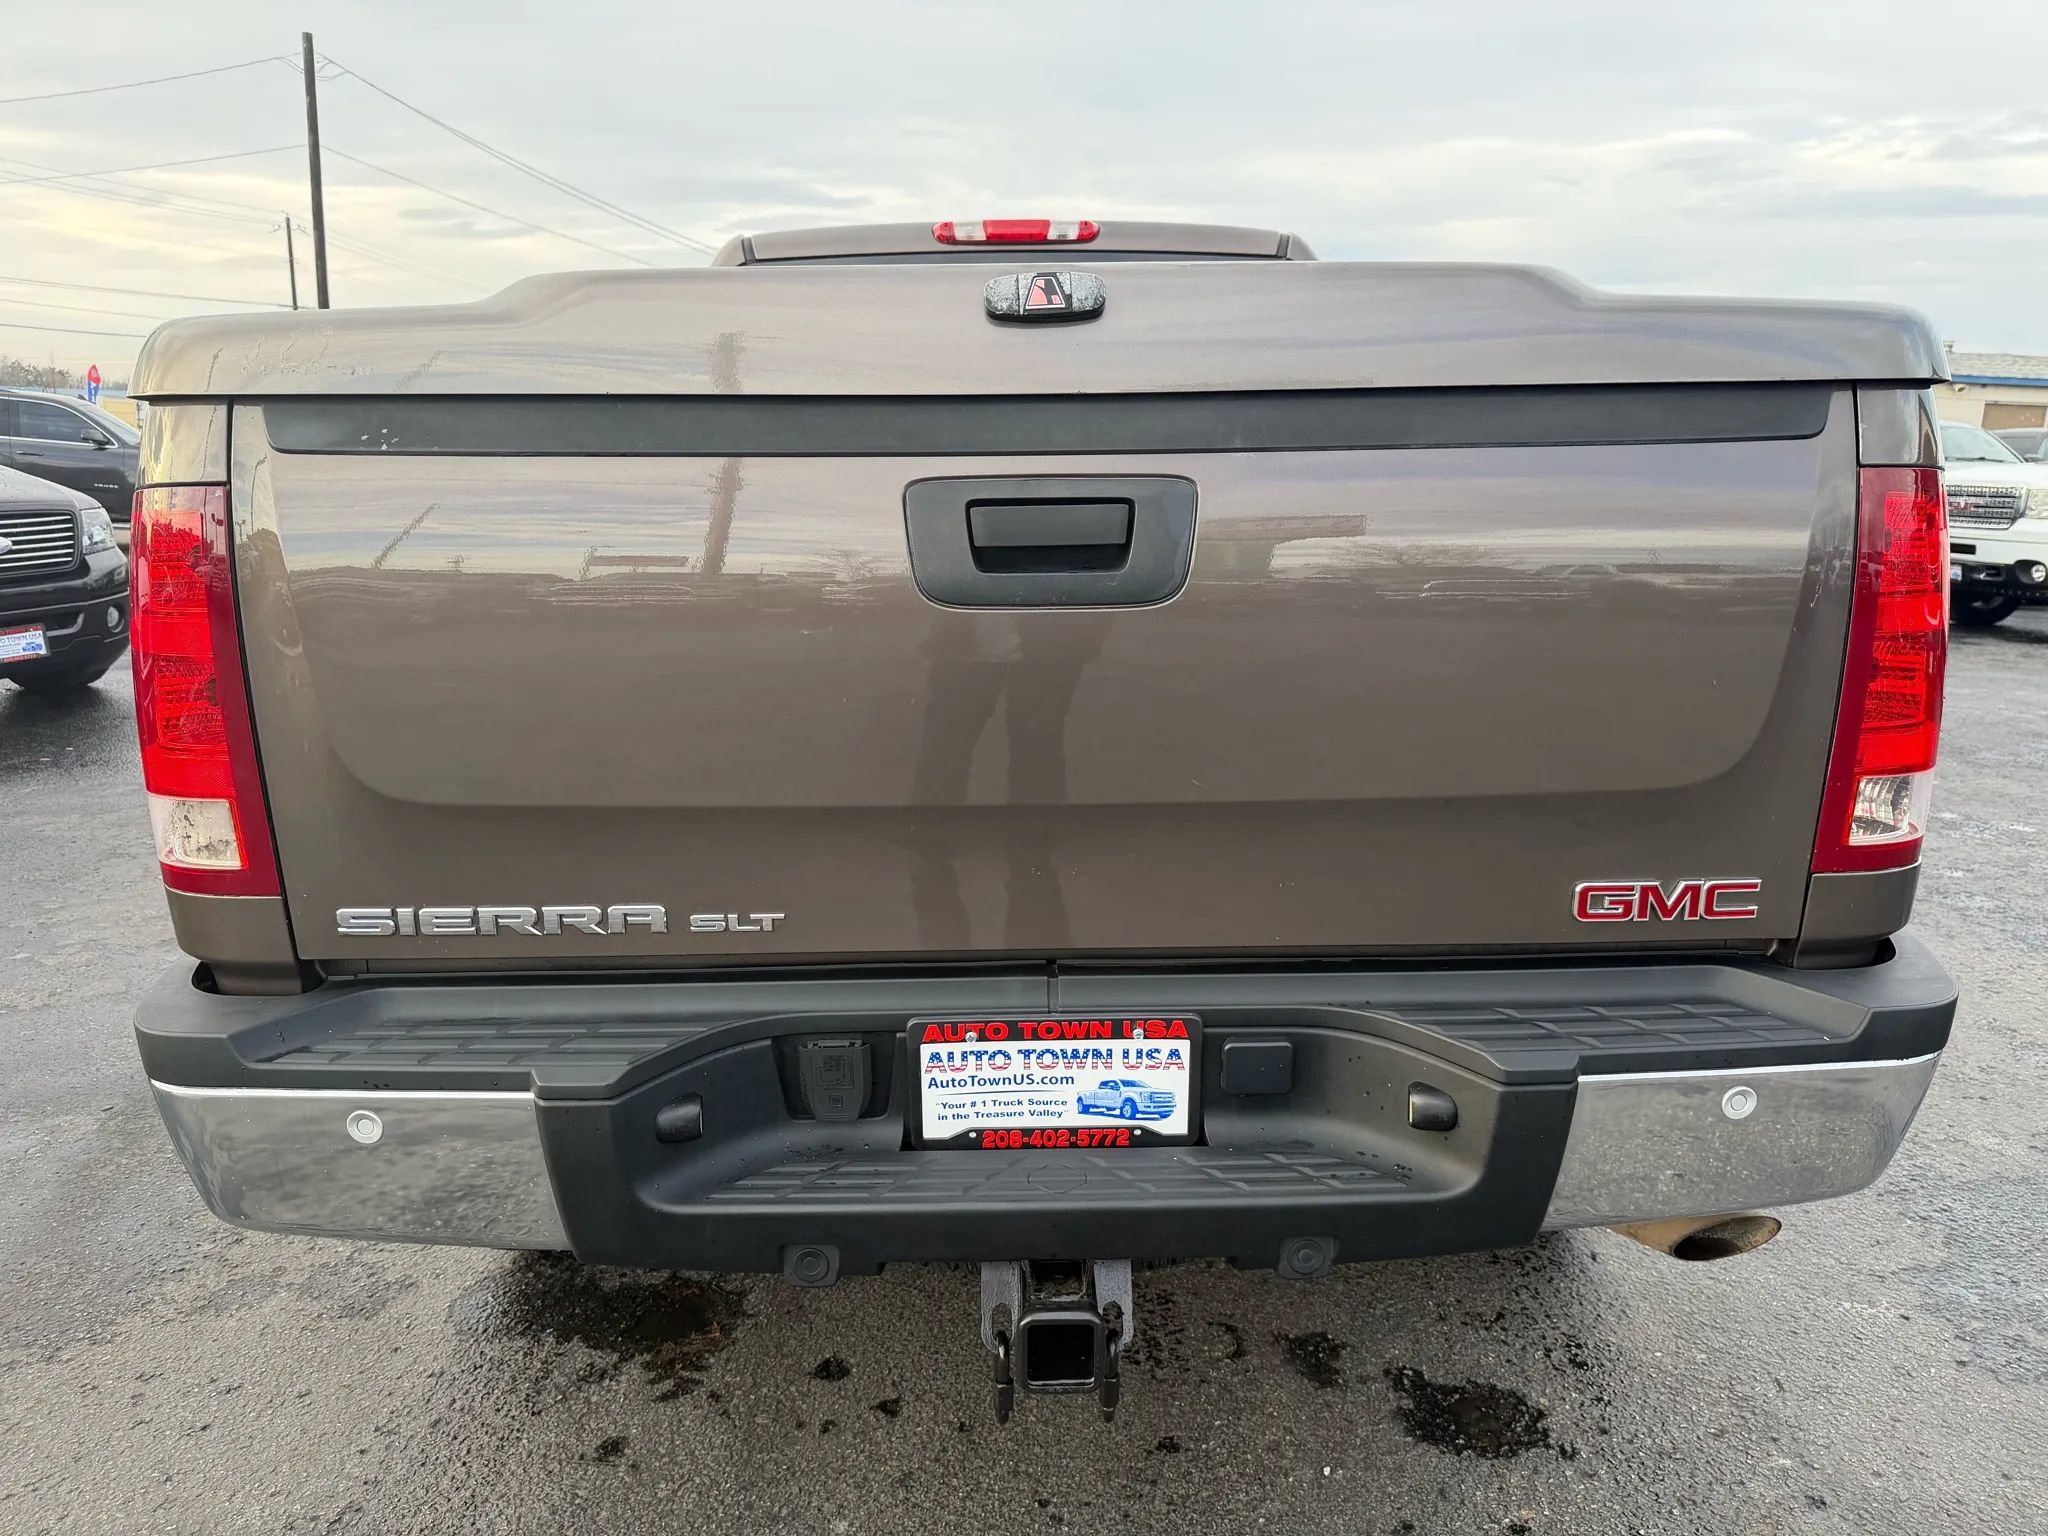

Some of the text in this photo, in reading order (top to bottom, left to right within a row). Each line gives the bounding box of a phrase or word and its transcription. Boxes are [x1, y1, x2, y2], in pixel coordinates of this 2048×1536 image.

[1573, 879, 1762, 922] GMC
[335, 905, 786, 937] SIERRA SLT
[922, 1020, 1188, 1042] AUTO TOWN USA
[924, 1048, 1185, 1074] AUTO TOWN USA
[928, 1073, 1075, 1089] AutoTownUS.com
[991, 1099, 1024, 1107] Truck
[1028, 1098, 1068, 1106] Source
[937, 1113, 948, 1121] in
[952, 1112, 970, 1120] the
[974, 1110, 1025, 1119] Treasure
[982, 1129, 1131, 1149] 208-402-5772
